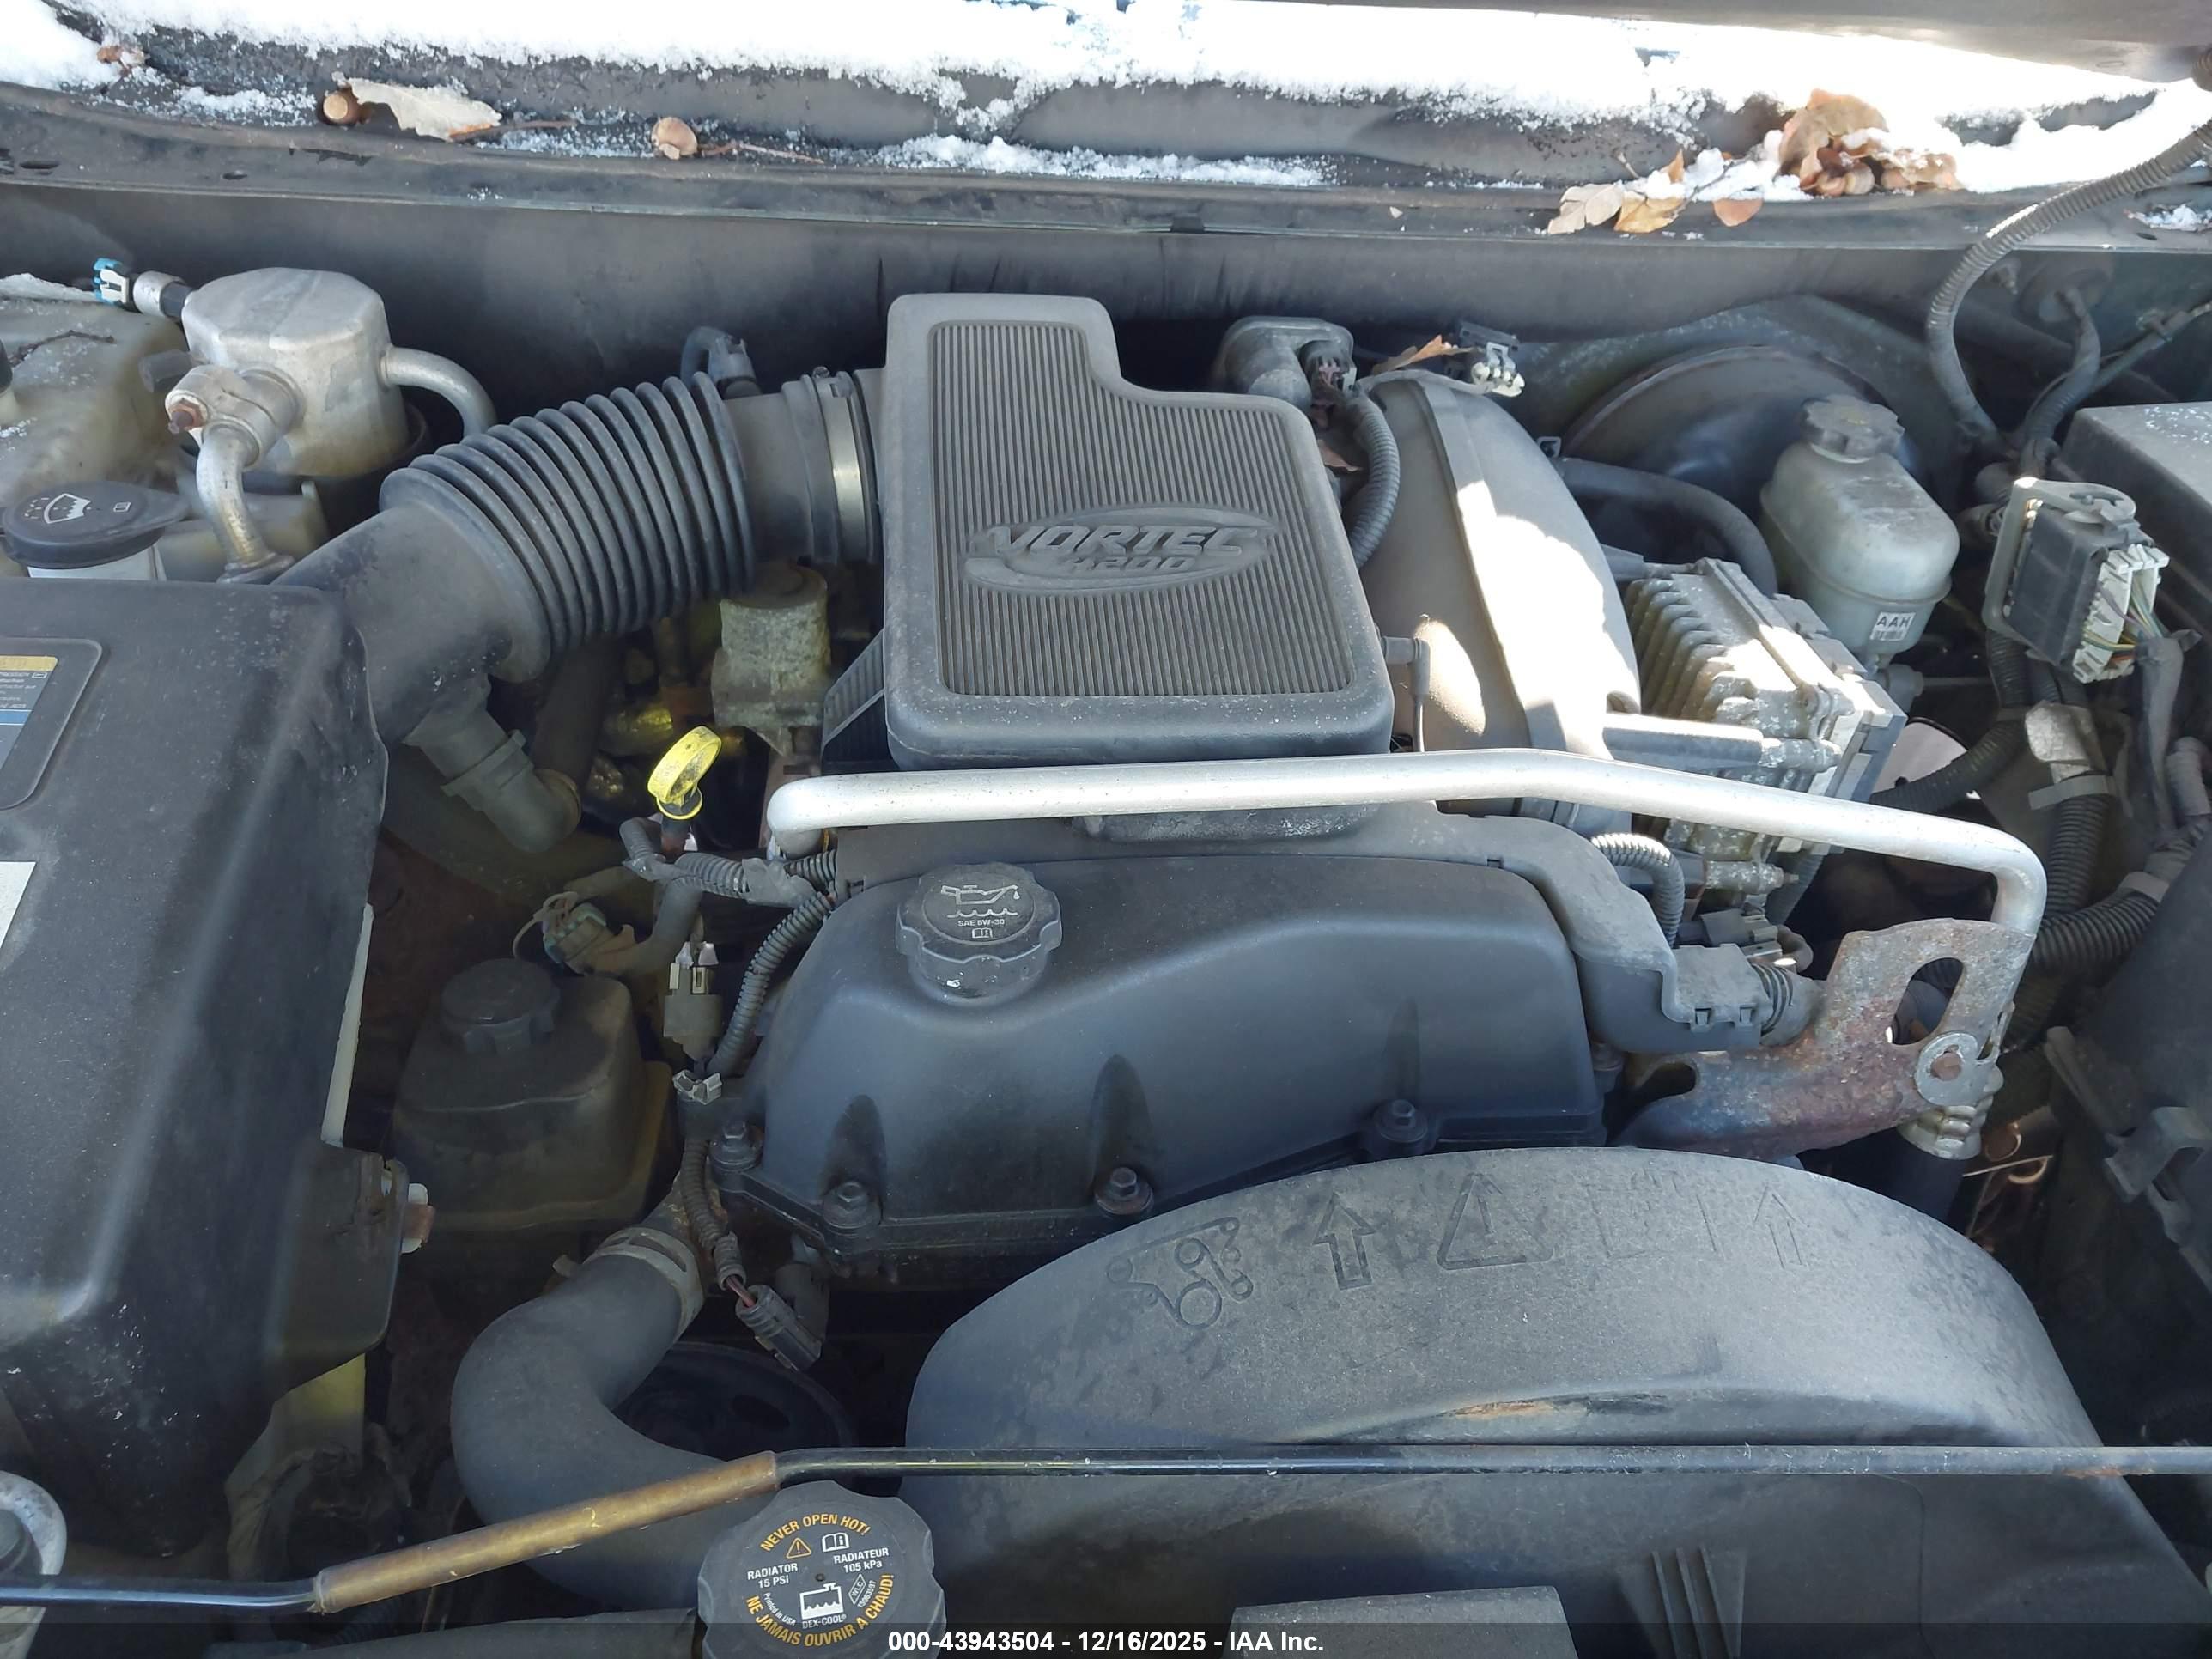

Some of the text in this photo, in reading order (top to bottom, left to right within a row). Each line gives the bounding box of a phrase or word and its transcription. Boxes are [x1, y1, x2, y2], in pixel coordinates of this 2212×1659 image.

[988, 524, 1259, 556] VORTEC
[760, 1513, 871, 1552] NEVER OPEN HOT!
[833, 1547, 890, 1564] RADIATEUR
[747, 1563, 799, 1581] RADIATOR
[843, 1559, 883, 1573] 105 kPa
[758, 1574, 789, 1589] 15 PSI
[746, 1574, 894, 1647] NE JAMAIS OUVRIR A CHAUD!
[781, 1614, 796, 1627] USA
